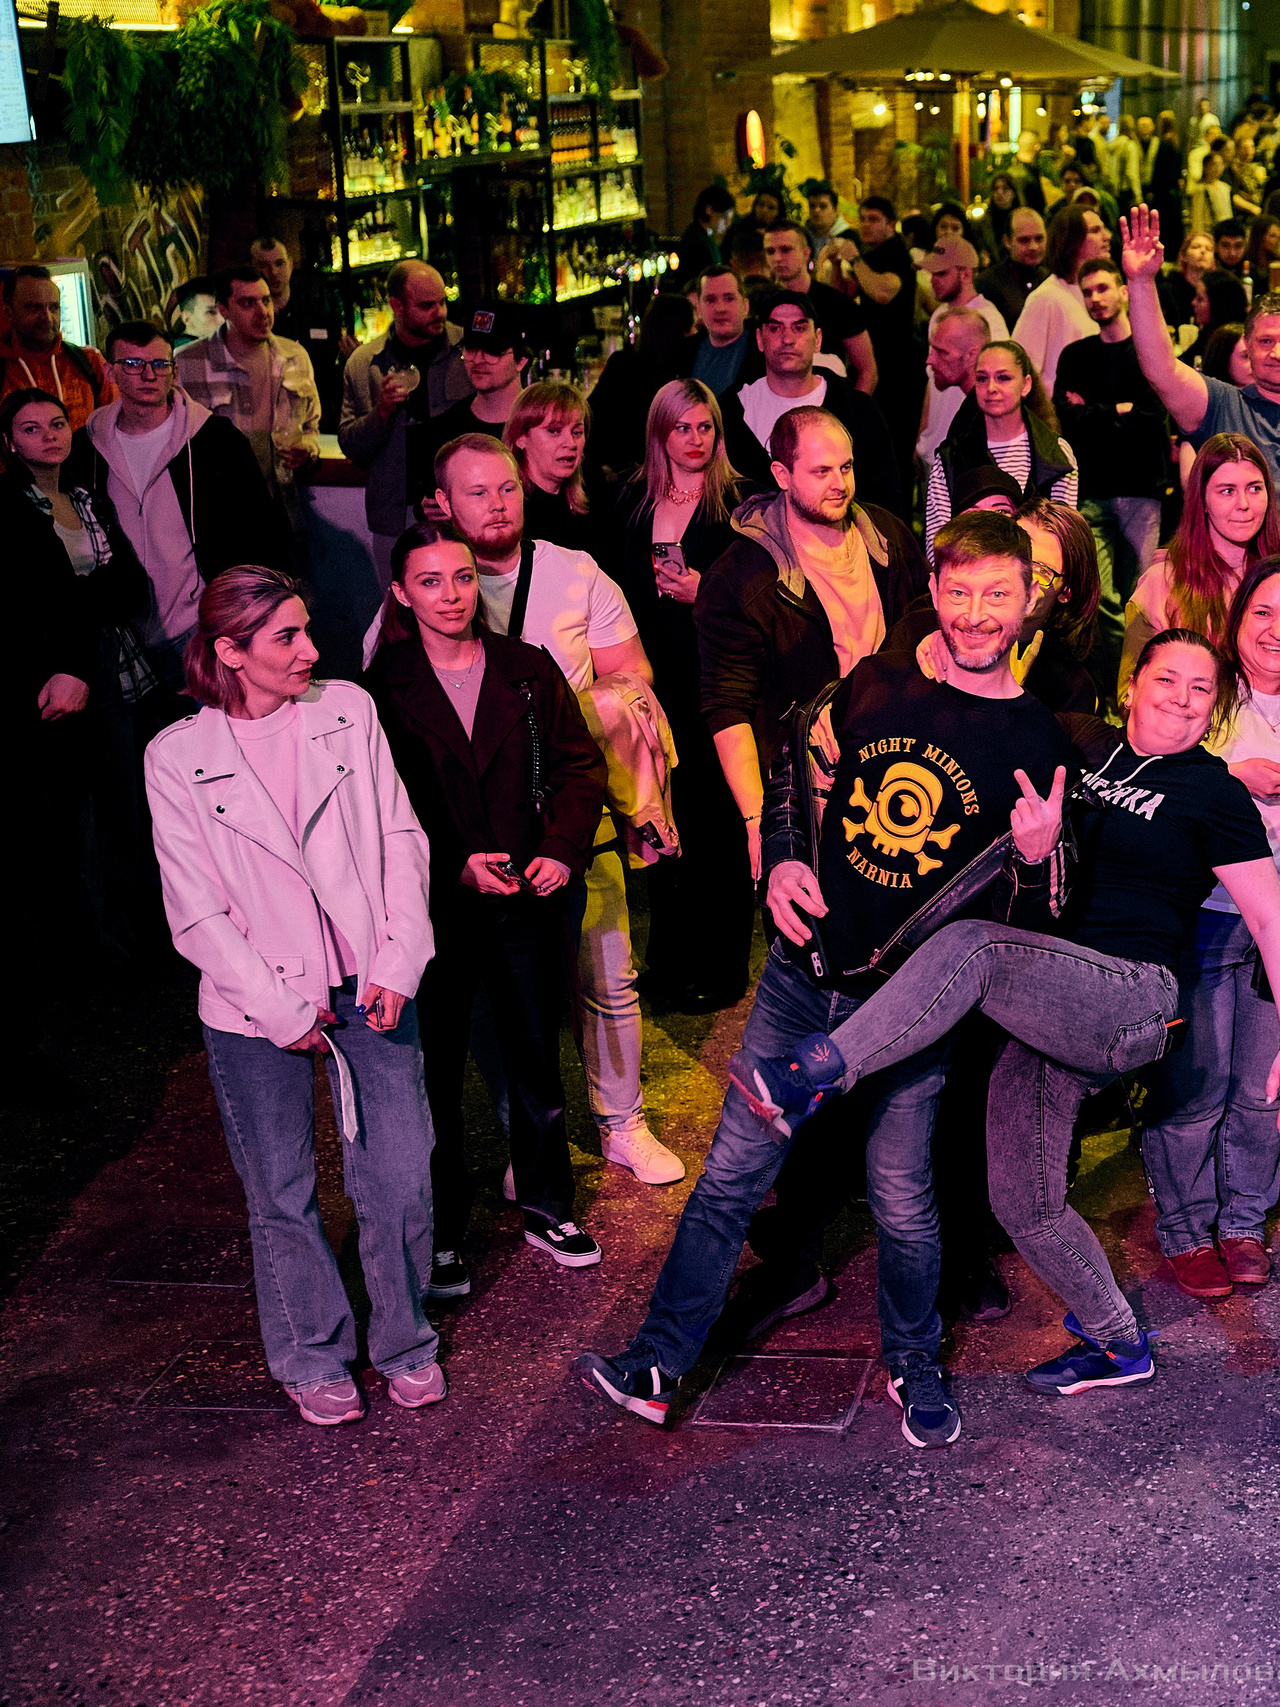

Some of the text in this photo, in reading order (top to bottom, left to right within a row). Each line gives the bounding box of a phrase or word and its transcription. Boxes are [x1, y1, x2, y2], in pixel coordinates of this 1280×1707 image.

[858, 737, 980, 816] NIGHT MINIONS
[846, 846, 913, 889] NARNIA
